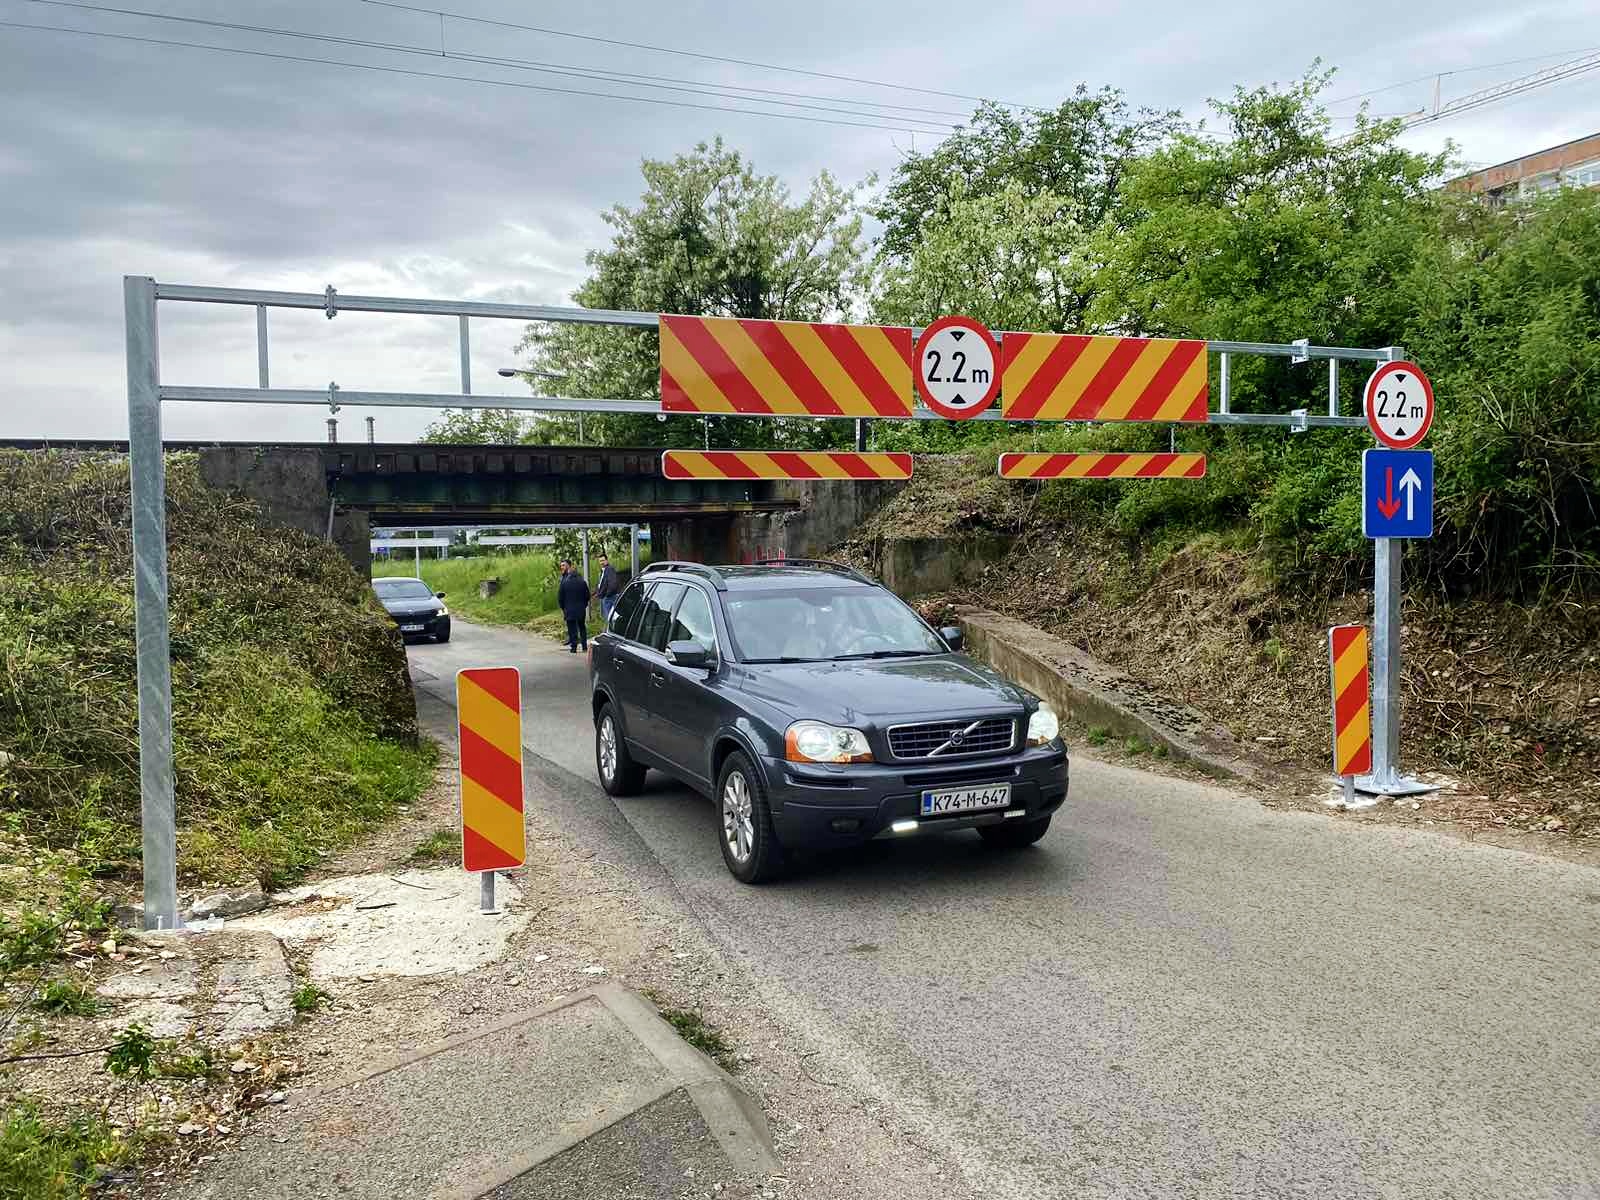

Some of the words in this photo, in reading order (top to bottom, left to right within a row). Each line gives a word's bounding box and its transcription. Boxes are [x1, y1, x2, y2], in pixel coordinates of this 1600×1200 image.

[927, 350, 967, 383] 2.2
[972, 369, 989, 383] m
[1377, 390, 1407, 418] 2.2
[1411, 406, 1424, 418] m
[934, 788, 1007, 811] K74-M-647
